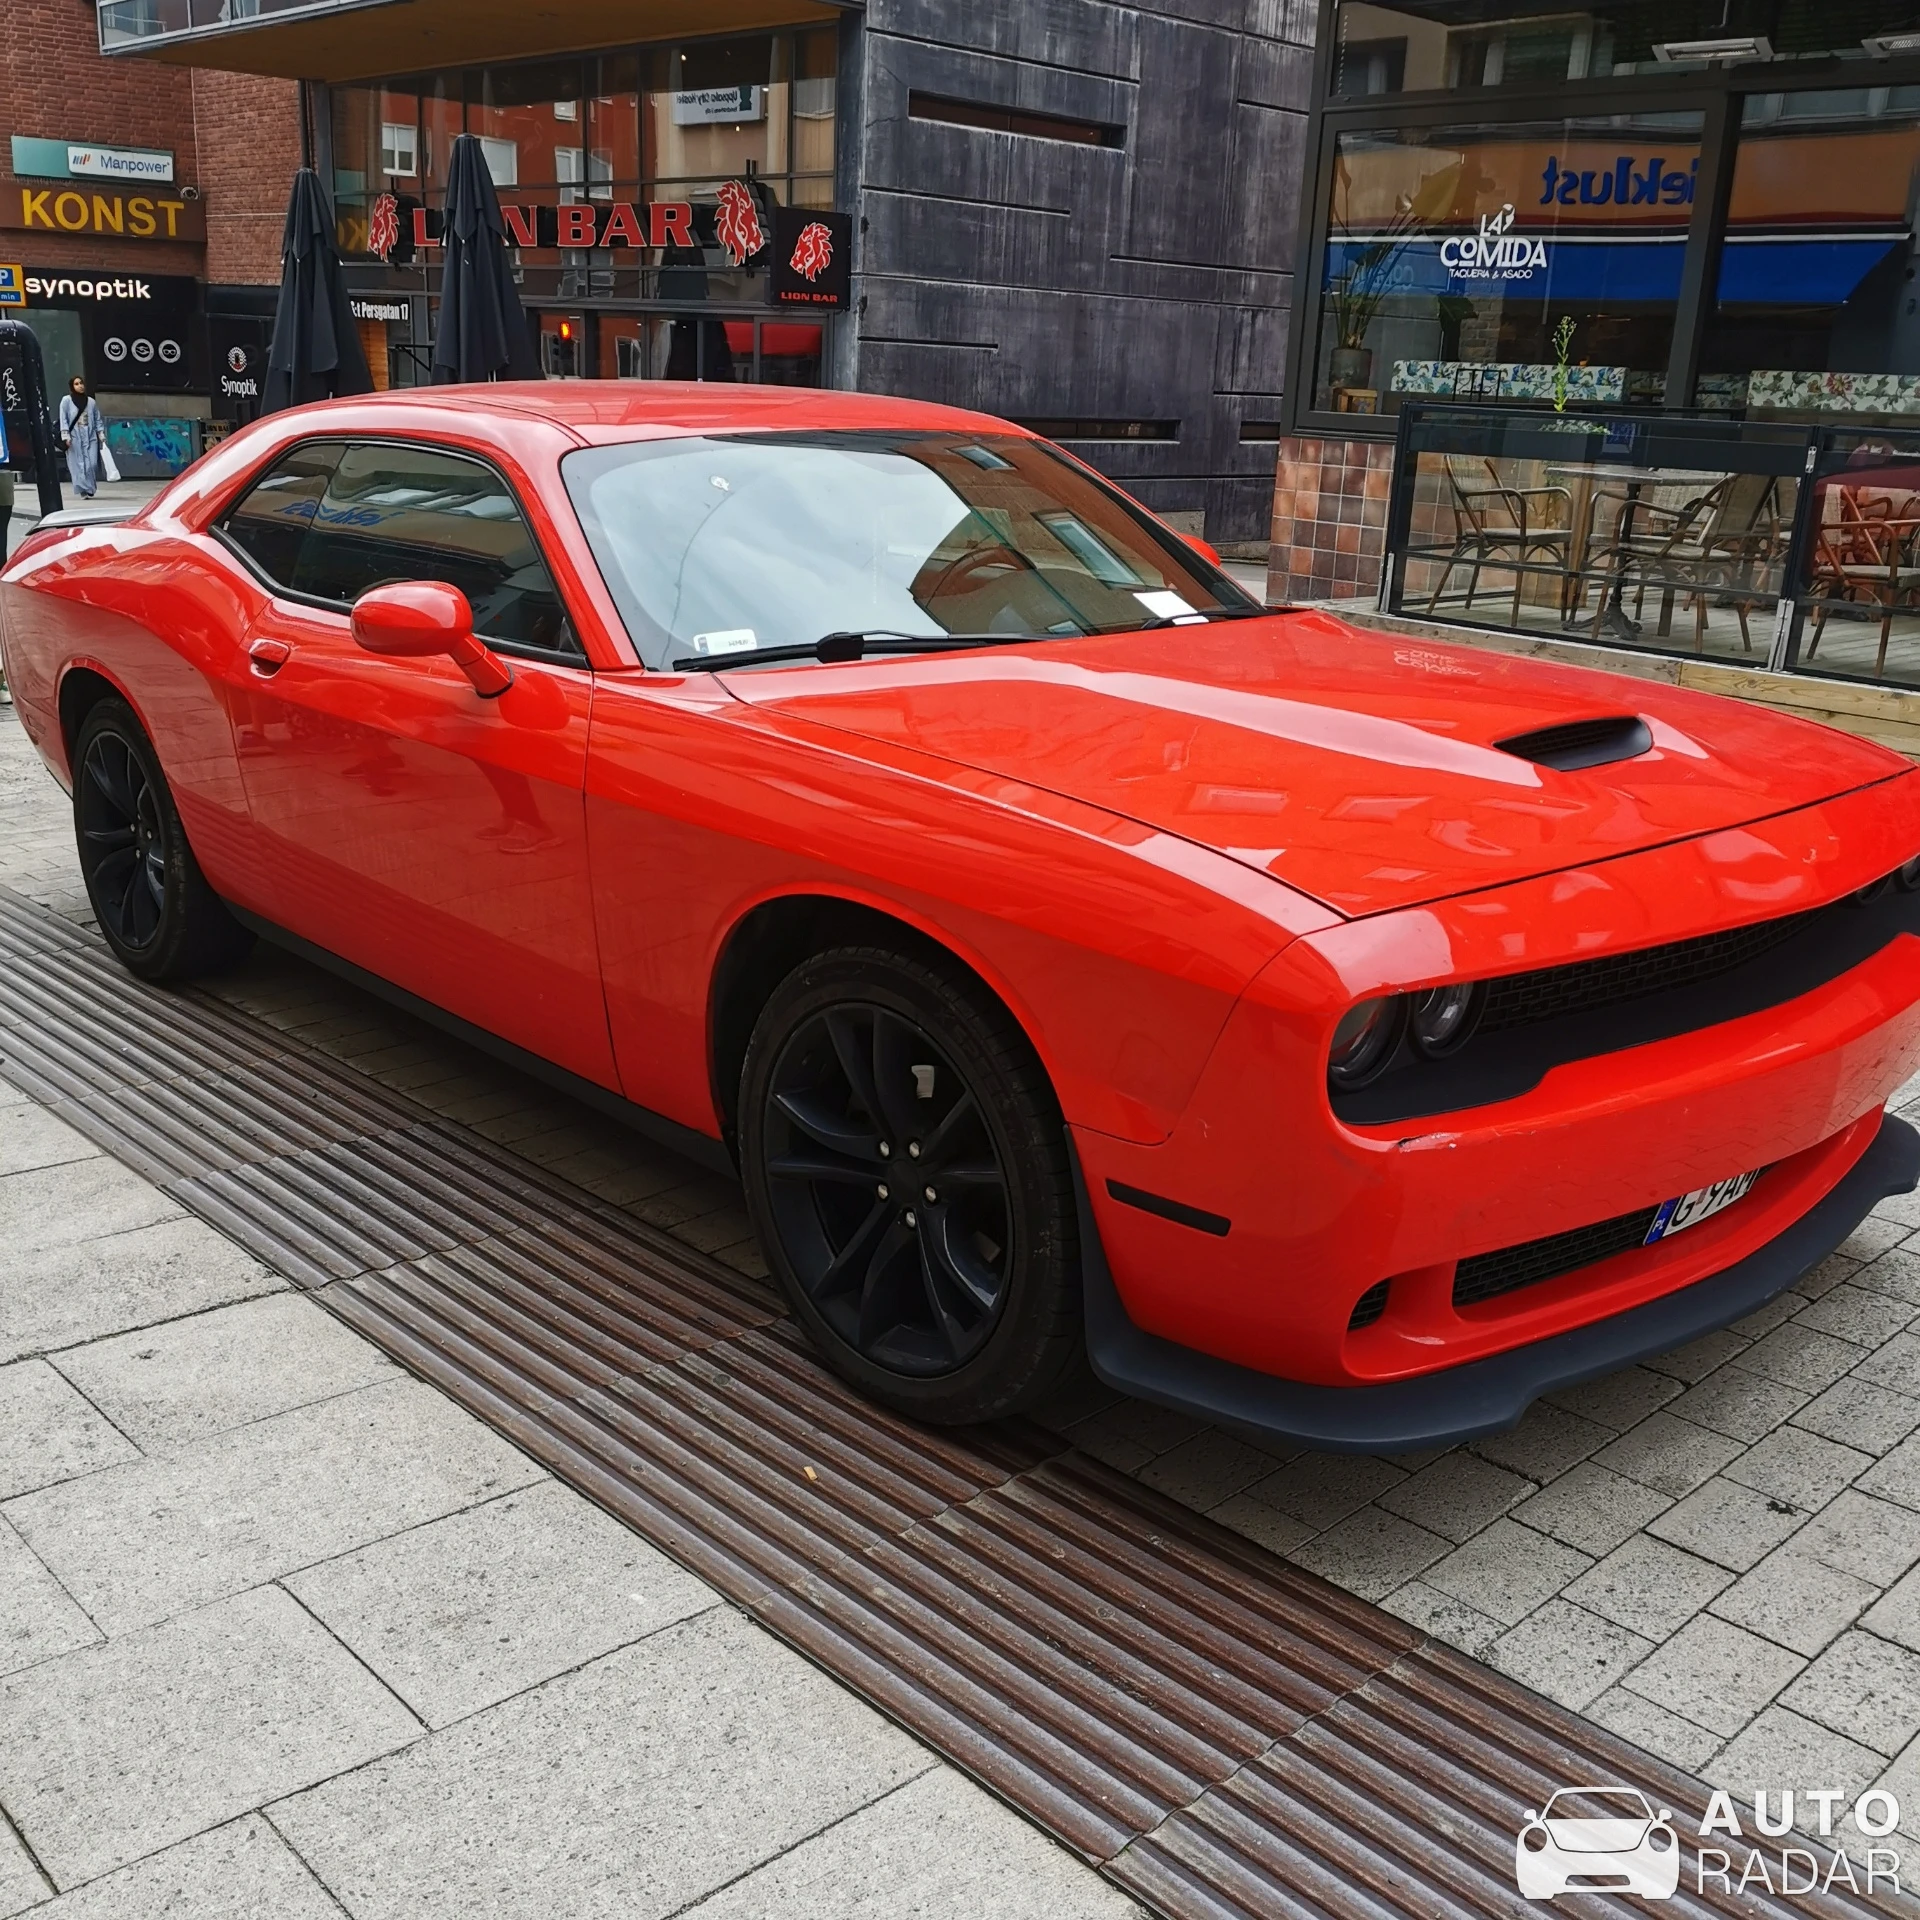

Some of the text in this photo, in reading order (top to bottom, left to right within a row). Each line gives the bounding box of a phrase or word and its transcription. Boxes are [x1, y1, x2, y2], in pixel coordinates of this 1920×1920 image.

[100, 155, 168, 174] Manpower
[22, 188, 185, 237] KONST
[413, 205, 537, 248] LN
[557, 201, 695, 248] BAR
[1479, 212, 1504, 237] LA
[1501, 269, 1532, 279] ASADO
[25, 276, 151, 301] synoptik
[781, 291, 838, 303] LION BAR
[361, 301, 400, 321] Persgatan
[400, 303, 408, 321] 17
[221, 375, 258, 399] Synoptik
[1652, 1218, 1665, 1233] PL
